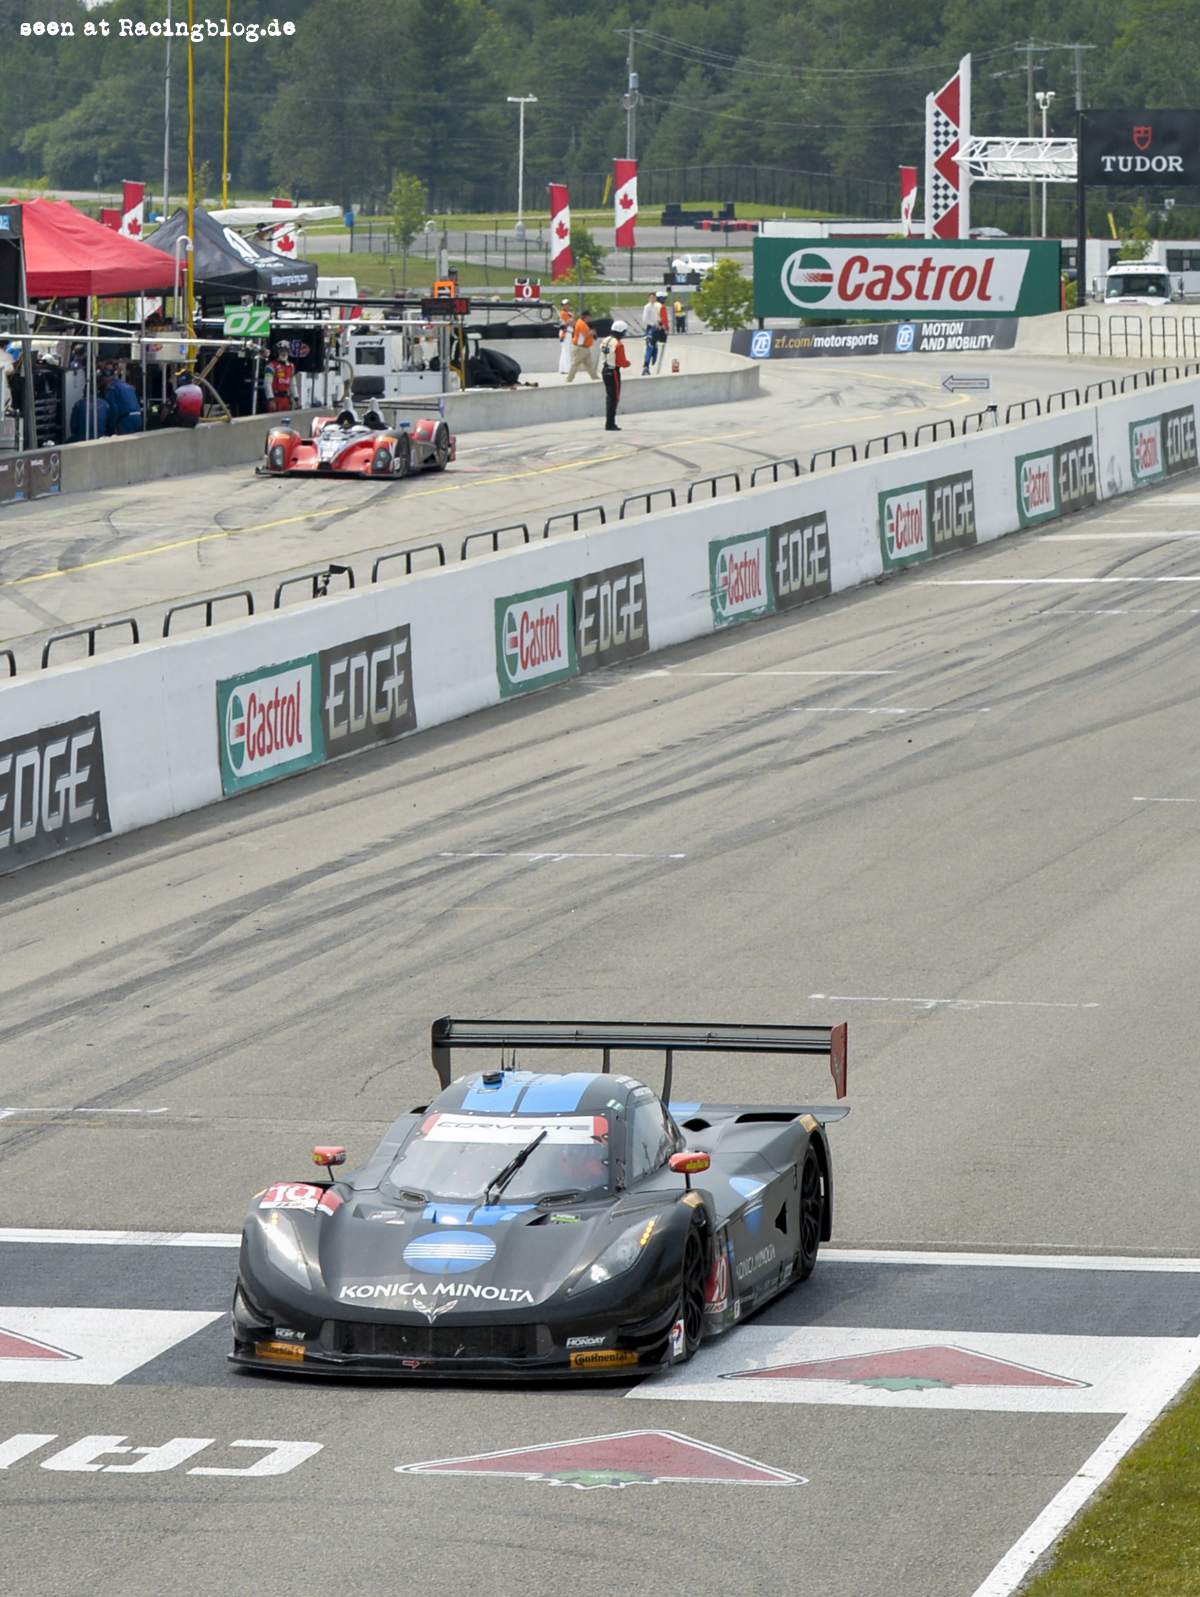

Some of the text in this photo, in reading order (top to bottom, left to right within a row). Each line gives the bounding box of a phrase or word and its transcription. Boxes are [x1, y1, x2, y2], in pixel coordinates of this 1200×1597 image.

[1101, 156, 1184, 172] TUDOR
[837, 255, 995, 302] Castrol
[223, 312, 271, 334] 07
[775, 333, 879, 350] zf.com/motorsports
[920, 335, 994, 351] AND MOBILITY
[921, 322, 964, 336] MOTION
[932, 480, 974, 543] EDGE
[727, 548, 762, 605] Castrol
[776, 523, 829, 597] EDGE
[519, 604, 562, 671] Castrol
[579, 574, 644, 658] EDGE
[325, 637, 409, 740] EDGE
[245, 680, 304, 761] Castrol
[437, 1121, 591, 1131] CORVETTE
[339, 1282, 535, 1303] KONICA MINOLTA
